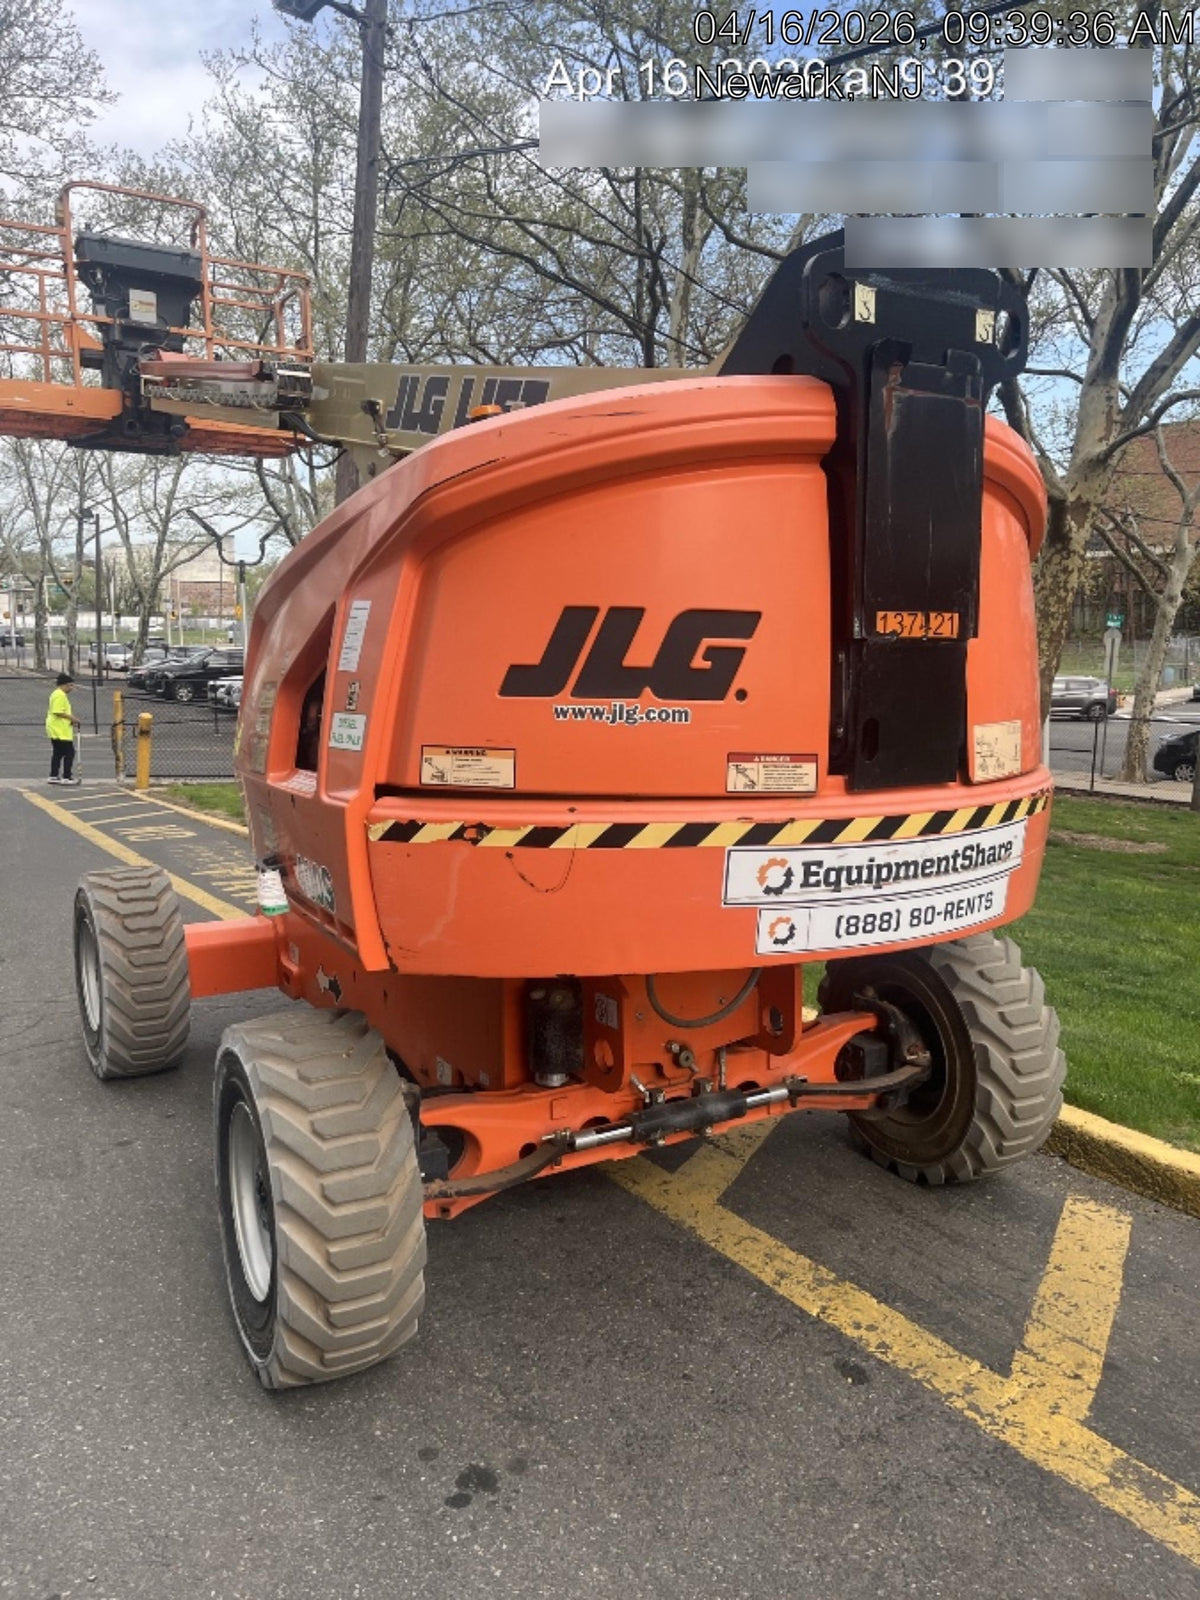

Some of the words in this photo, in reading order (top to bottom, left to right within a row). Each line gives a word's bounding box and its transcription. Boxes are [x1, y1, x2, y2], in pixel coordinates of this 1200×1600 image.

[385, 374, 452, 436] JLG
[553, 702, 691, 725] www.jlg.com
[800, 839, 1014, 893] EquipmentShare
[834, 909, 902, 939] (888)
[908, 890, 994, 928] 80-RENTS
